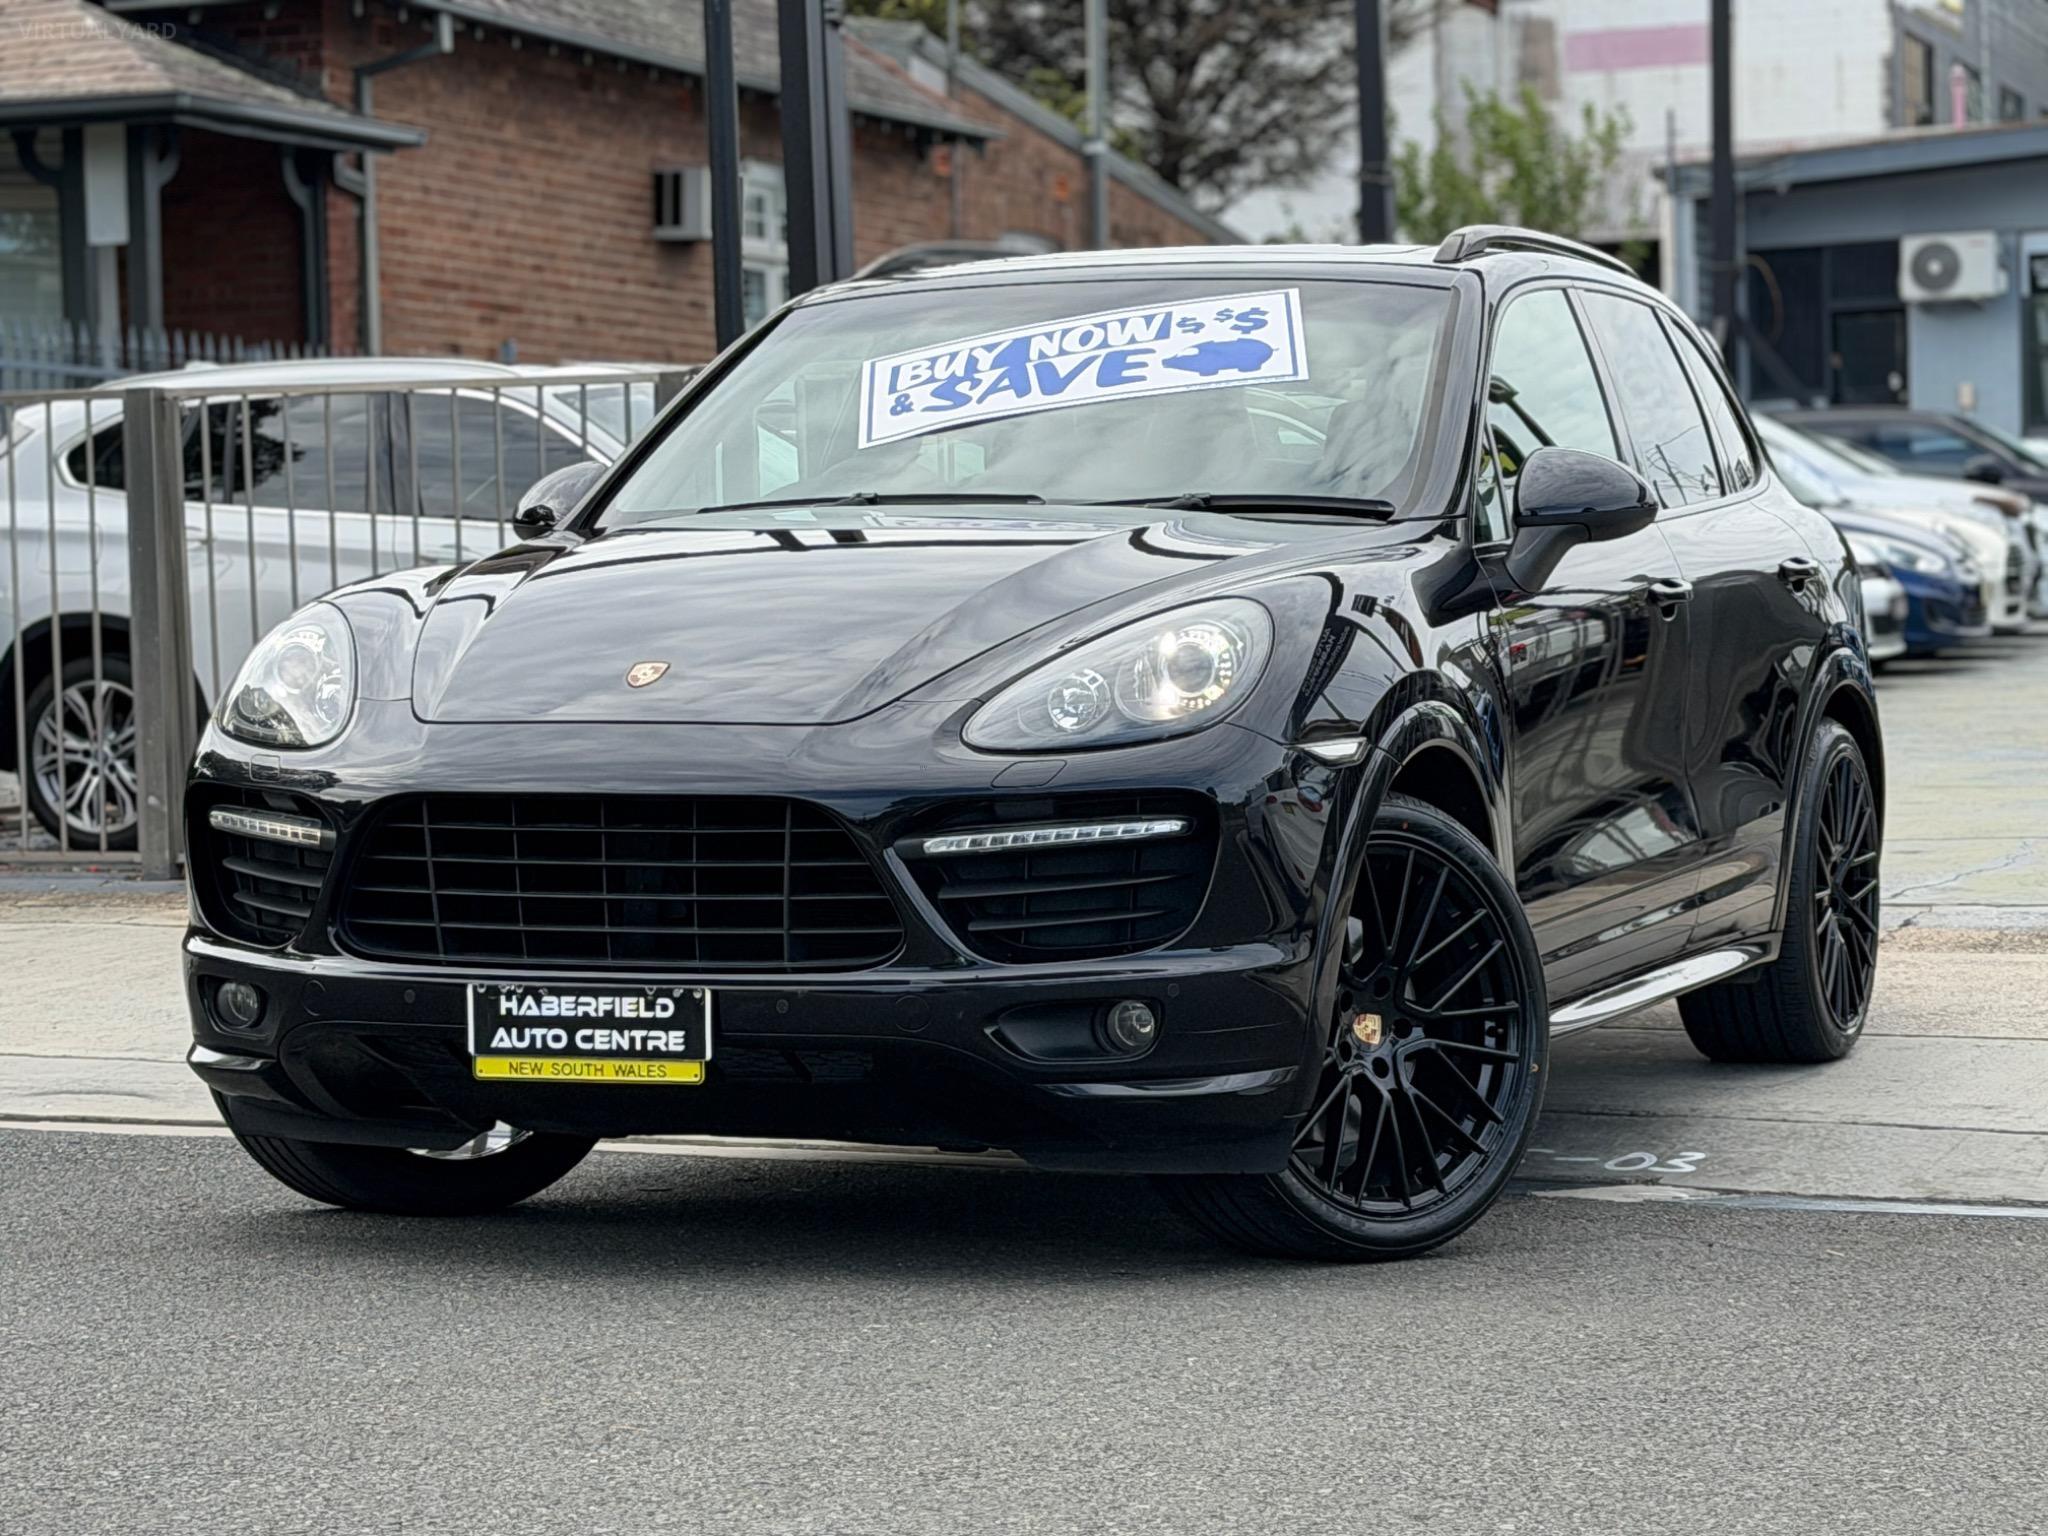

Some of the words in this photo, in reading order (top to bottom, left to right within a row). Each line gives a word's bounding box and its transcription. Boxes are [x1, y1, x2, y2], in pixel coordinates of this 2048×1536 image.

[896, 341, 1014, 390] BUY
[1029, 313, 1168, 361] NOW
[889, 393, 914, 416] &
[920, 347, 1158, 413] SAVE
[499, 994, 675, 1018] HABERFIELD
[490, 1027, 568, 1049] AUTO
[575, 1029, 686, 1052] CENTRE
[508, 1061, 544, 1075] NEW
[551, 1063, 604, 1077] SOUTH
[613, 1063, 668, 1078] WALES
